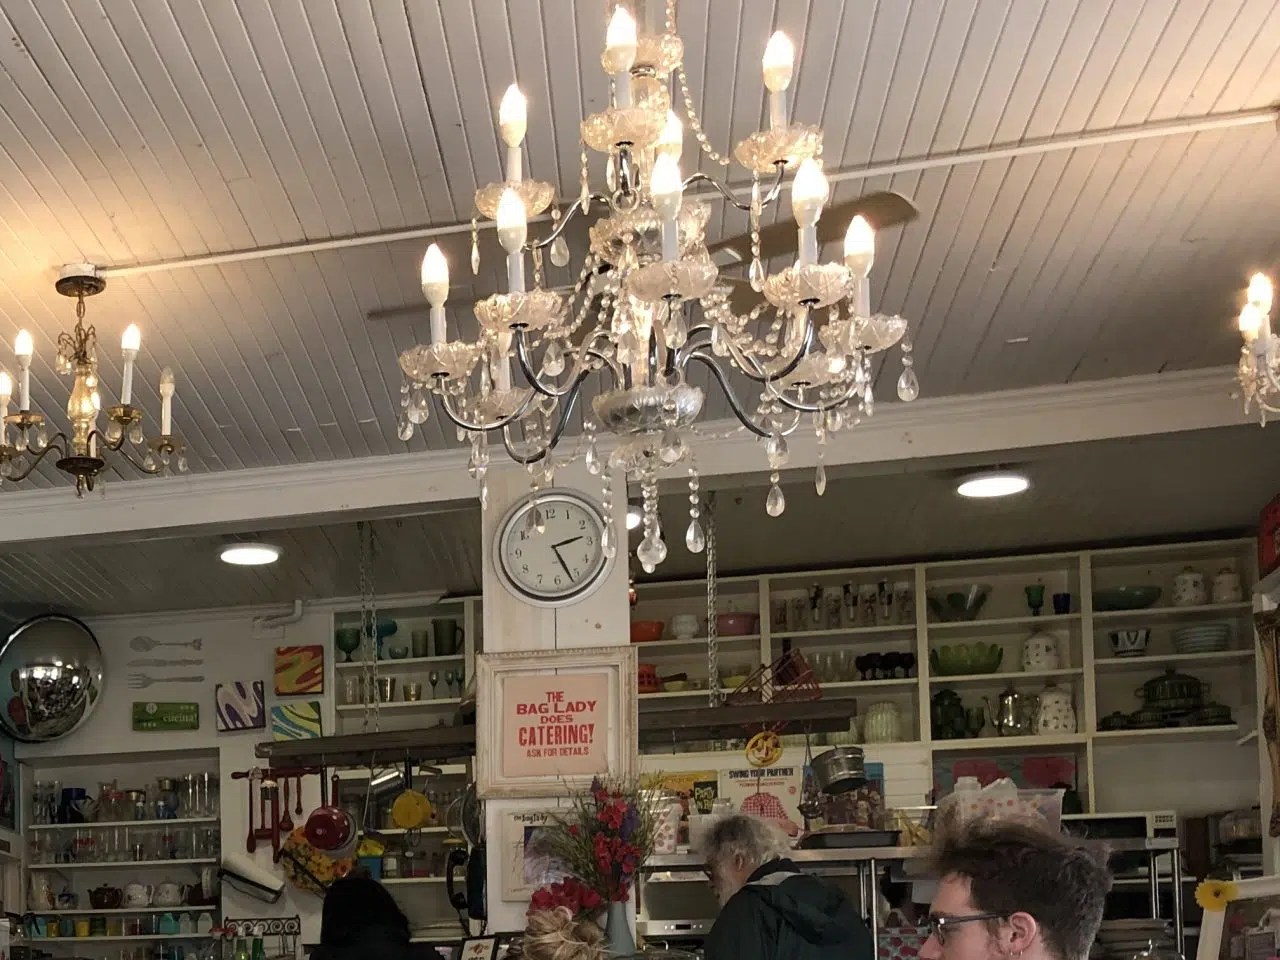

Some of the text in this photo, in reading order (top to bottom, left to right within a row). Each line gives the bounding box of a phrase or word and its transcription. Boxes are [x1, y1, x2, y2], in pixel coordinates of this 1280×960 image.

[545, 509, 556, 520] 12
[565, 510, 570, 520] 1
[579, 520, 586, 530] 2
[586, 537, 593, 546] 3
[515, 549, 522, 559] 9
[583, 554, 589, 564] 4
[522, 564, 529, 574] 8
[573, 568, 580, 578] 5
[537, 575, 544, 584] 7
[554, 575, 561, 585] 6
[546, 691, 564, 703] THE
[516, 700, 597, 715] BAG LADY
[540, 714, 573, 724] DOES
[519, 723, 595, 746] CATERING!
[527, 746, 589, 758] ASK FOR DETAILS
[729, 767, 794, 779] SWING YOUR PARTNER
